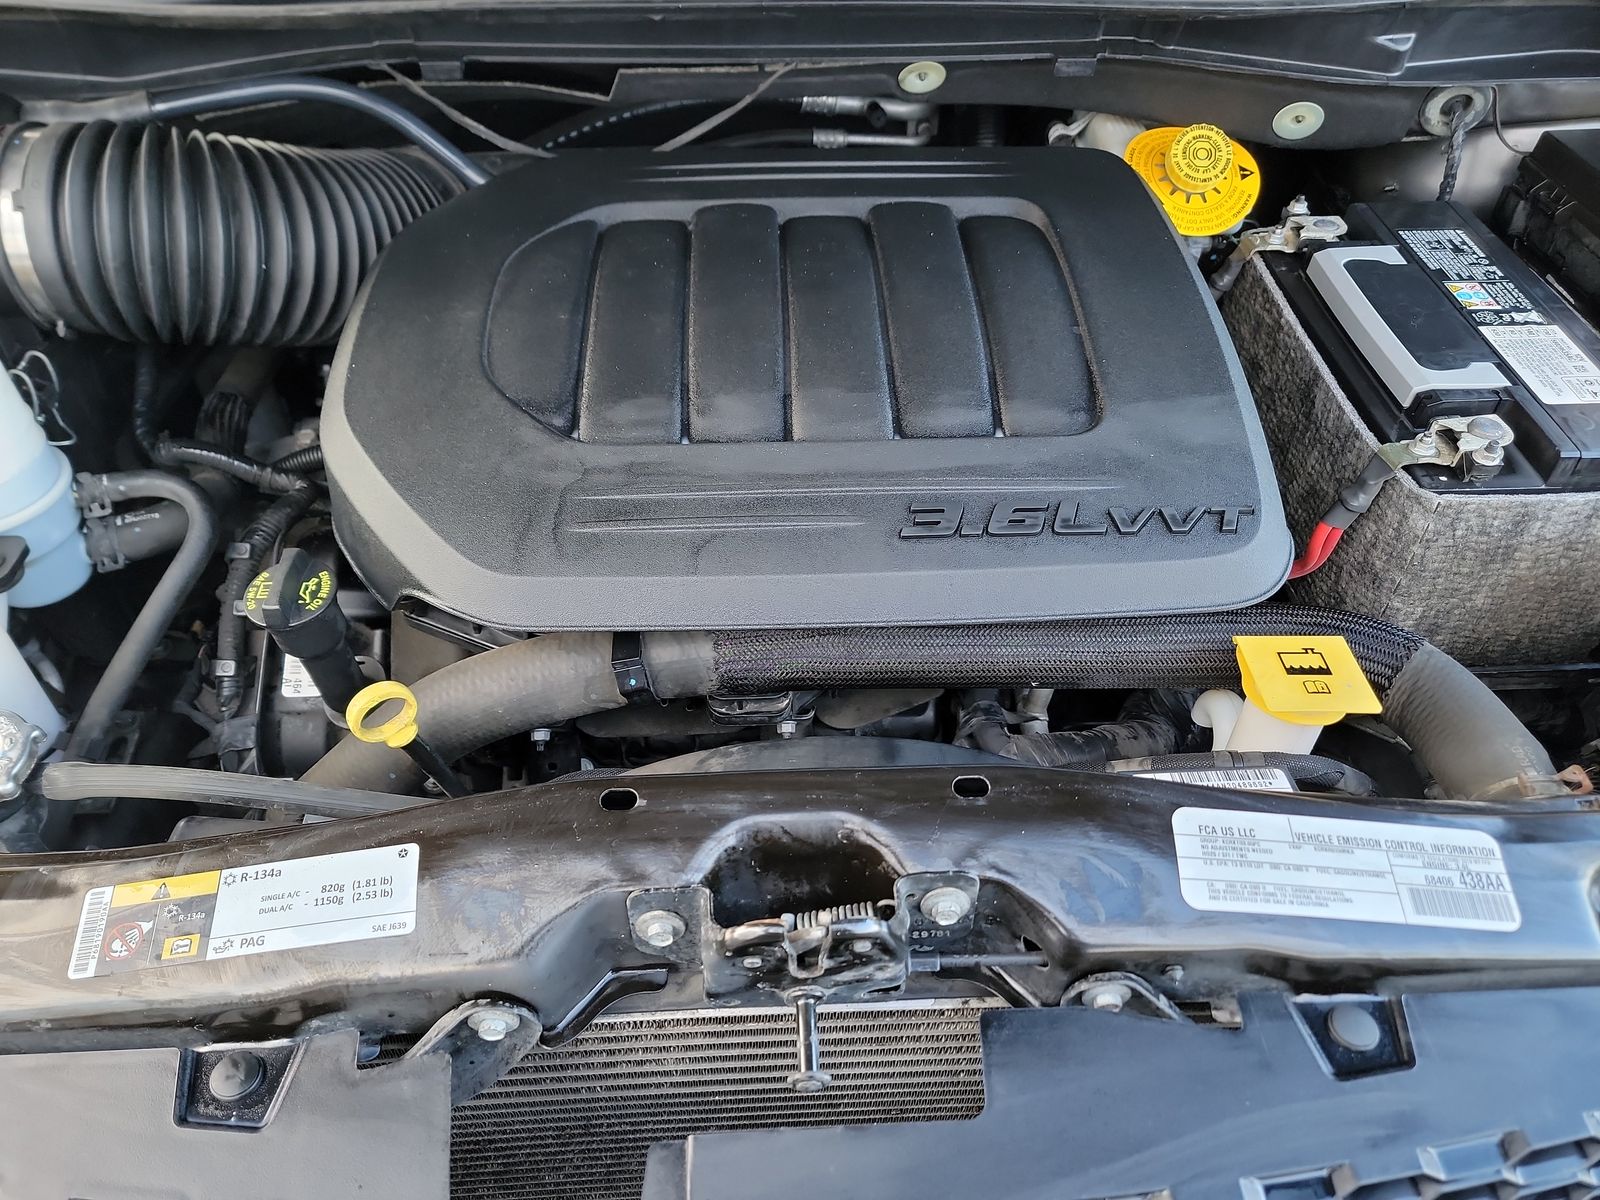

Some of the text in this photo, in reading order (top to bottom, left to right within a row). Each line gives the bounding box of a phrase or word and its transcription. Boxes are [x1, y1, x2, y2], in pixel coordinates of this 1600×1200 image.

[305, 570, 331, 611] ENGINE OIL
[1198, 824, 1256, 838] FCA US LLC
[1294, 831, 1496, 857] VEHICLE EMISSION CONTROL INFORMATION
[240, 868, 282, 882] R-134a
[1459, 871, 1505, 890] 438AA
[260, 892, 286, 903] SINGLE
[287, 889, 301, 899] A/C
[321, 883, 346, 895] 820g
[352, 877, 377, 892] (1.81
[379, 875, 393, 887] lb)
[258, 905, 278, 915] DUAL
[279, 903, 293, 913] A/C
[313, 895, 344, 907] 1150g
[352, 890, 377, 904] (2.53
[379, 887, 393, 899] lb)
[178, 912, 206, 923] R-134a
[371, 921, 407, 933] SAE J639
[240, 935, 265, 949] PAG
